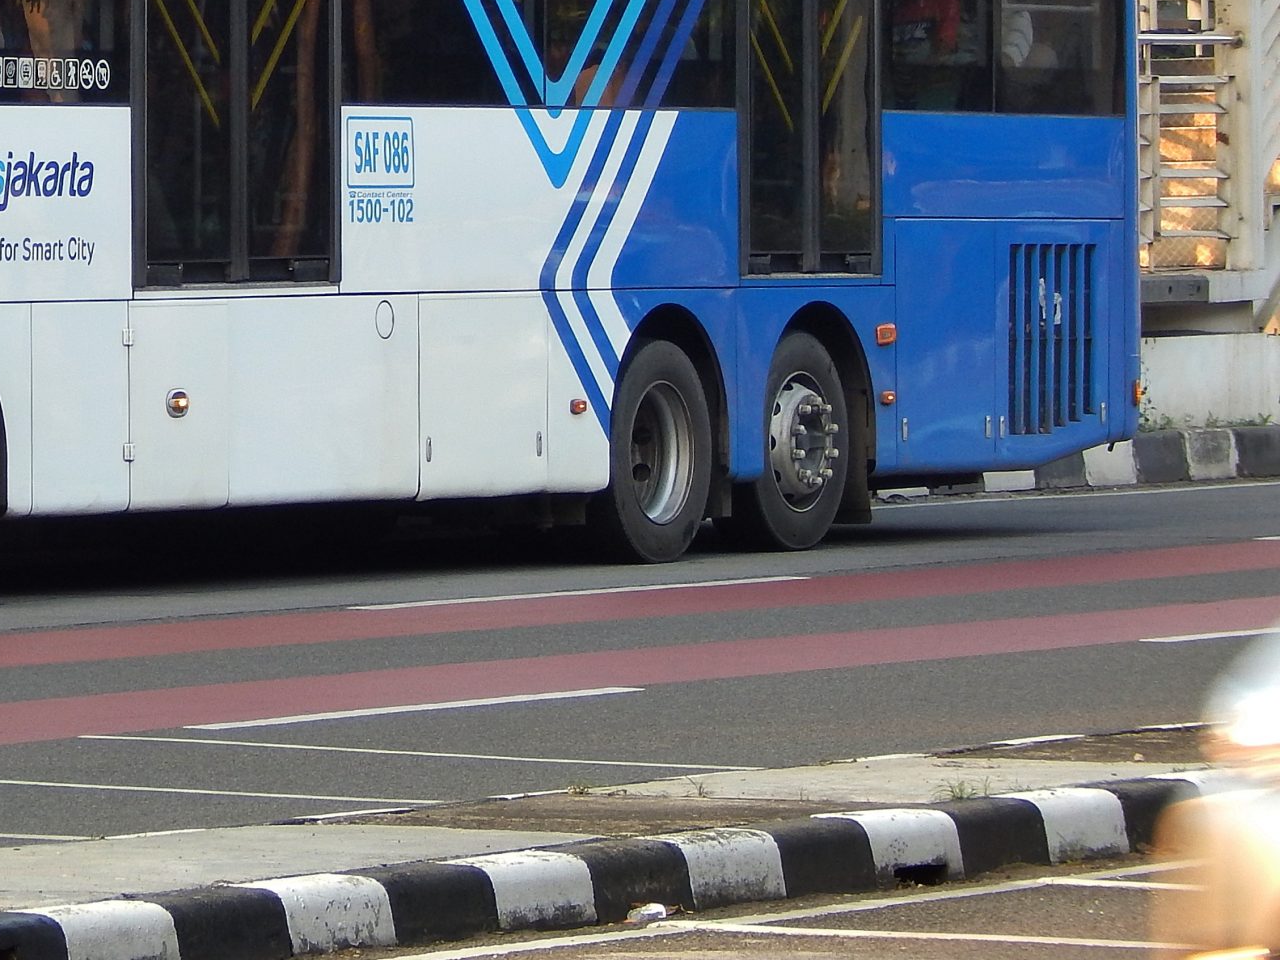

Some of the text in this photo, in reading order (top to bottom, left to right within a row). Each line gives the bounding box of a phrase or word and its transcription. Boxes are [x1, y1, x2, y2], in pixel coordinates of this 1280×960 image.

[354, 131, 409, 173] SAF 086
[349, 199, 413, 222] 1500-102
[0, 238, 19, 261] for
[22, 238, 63, 261] Smart
[67, 237, 95, 266] City
